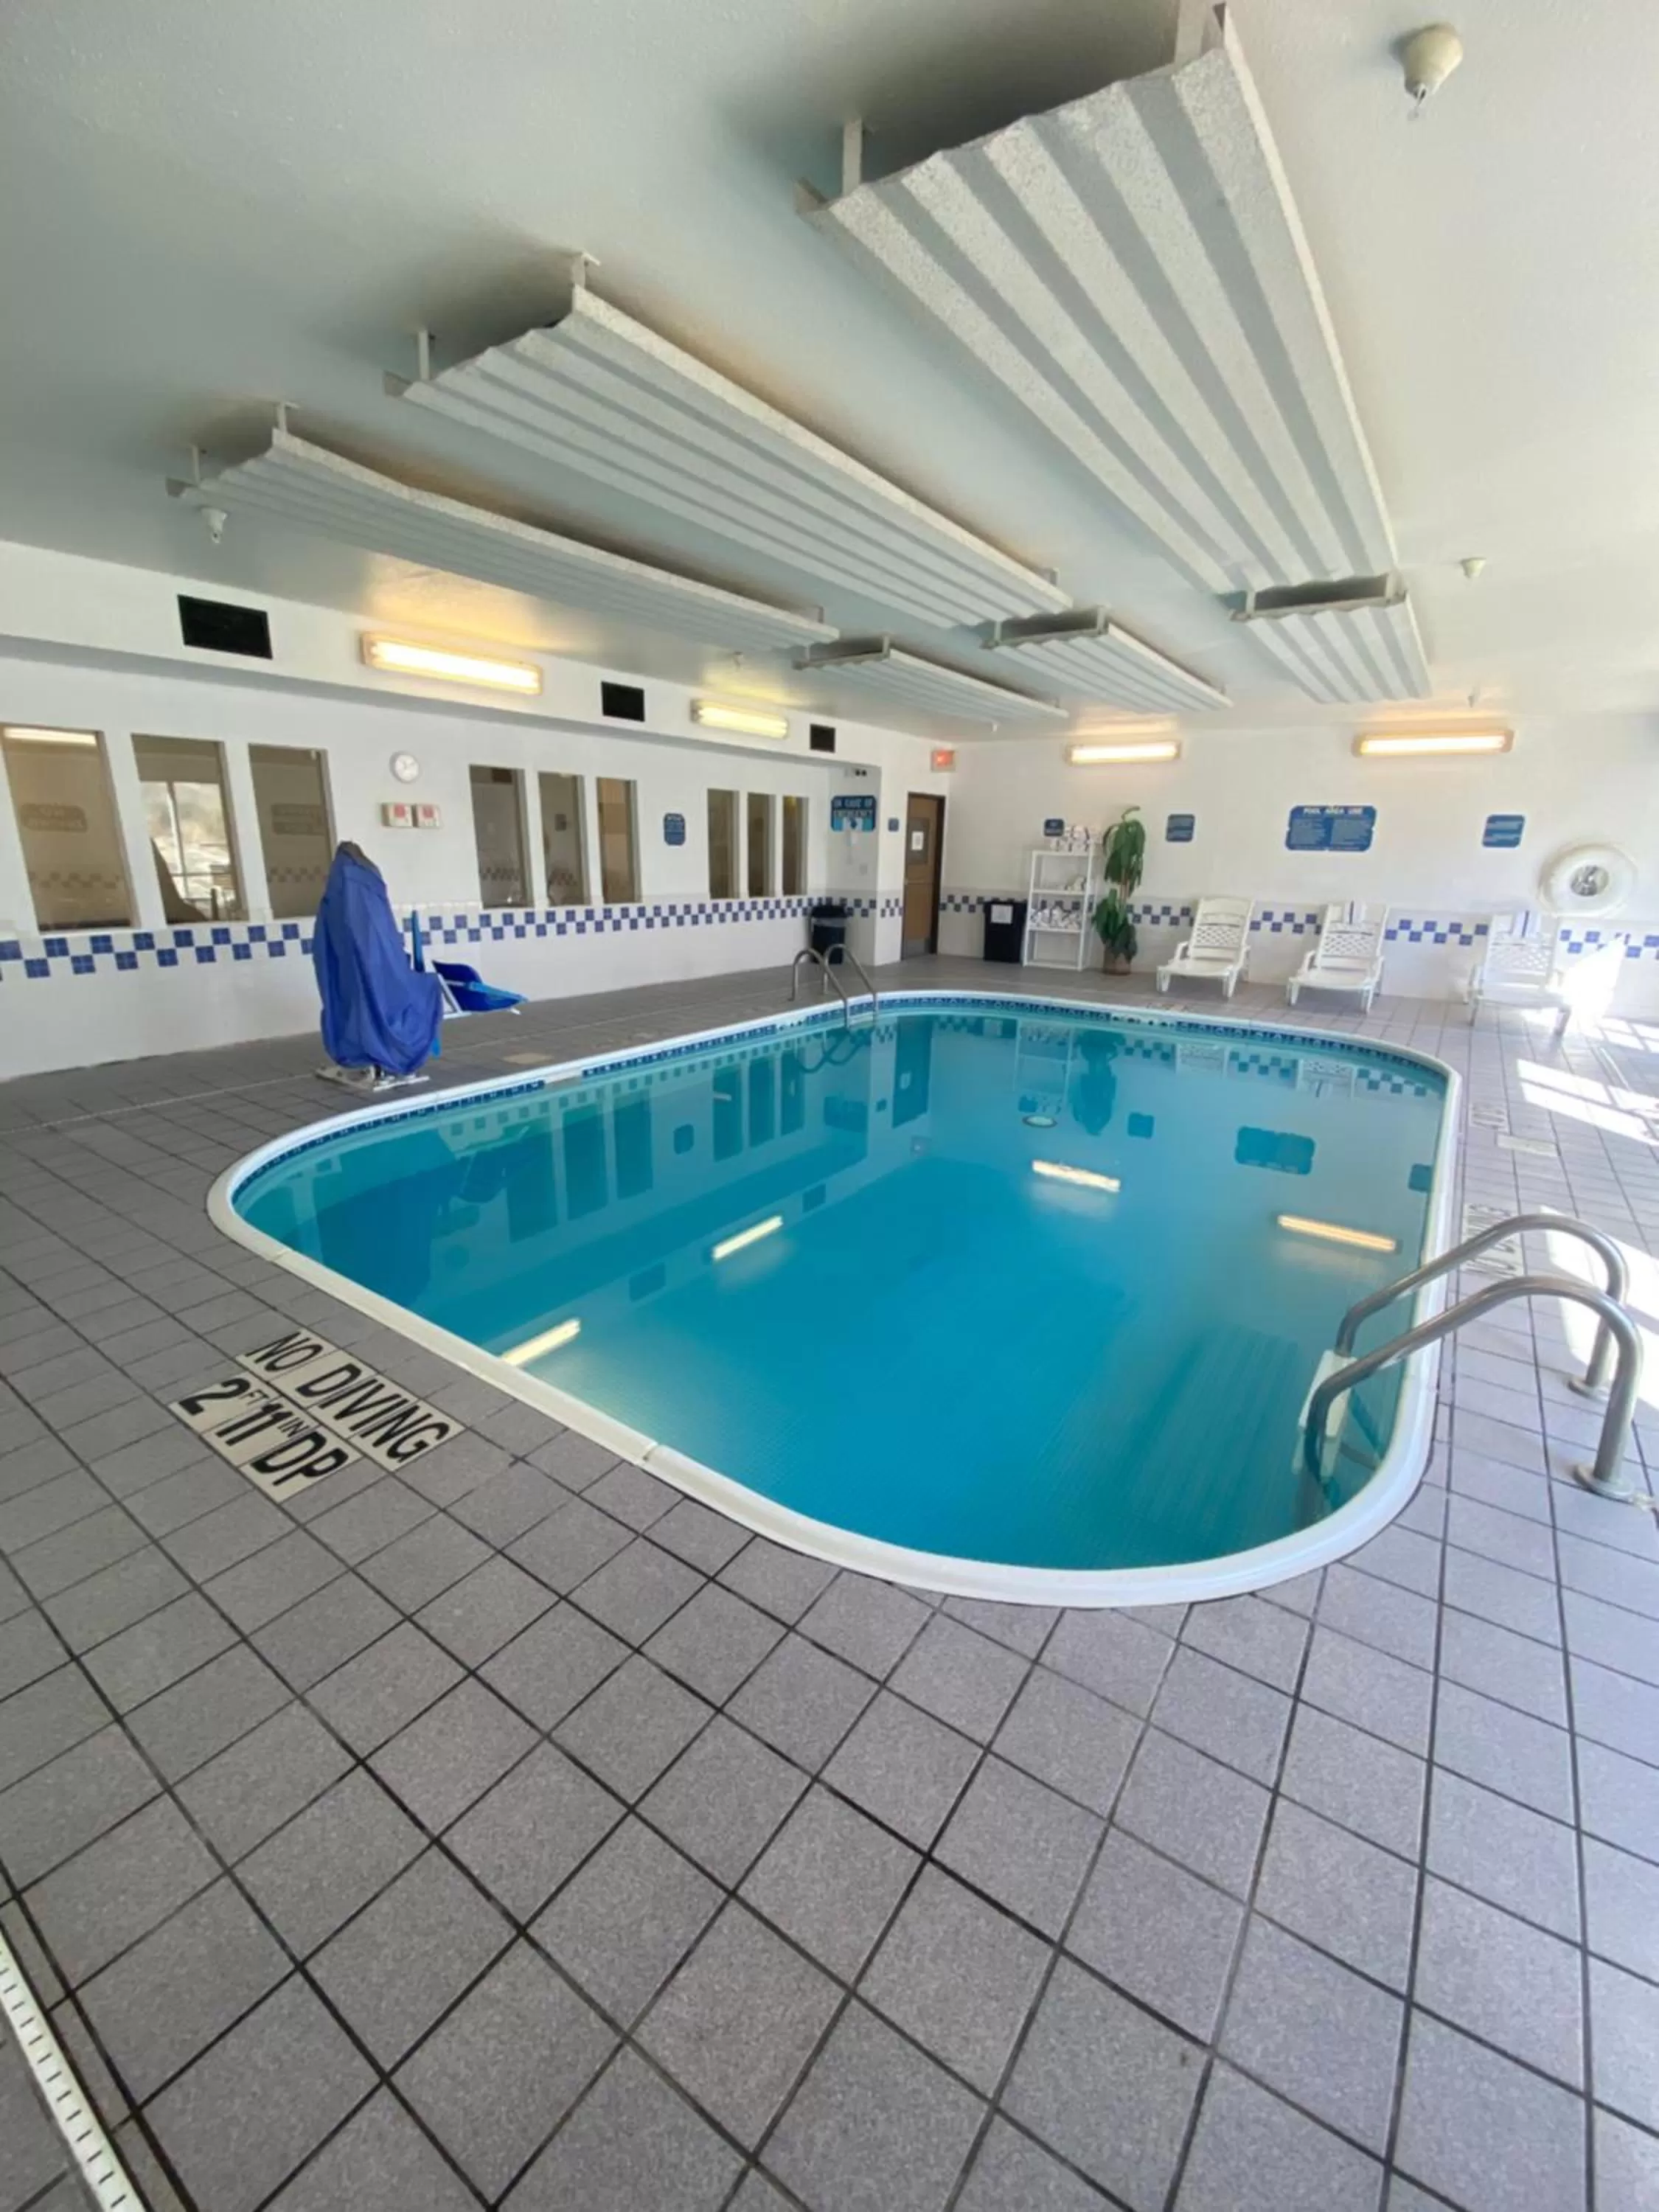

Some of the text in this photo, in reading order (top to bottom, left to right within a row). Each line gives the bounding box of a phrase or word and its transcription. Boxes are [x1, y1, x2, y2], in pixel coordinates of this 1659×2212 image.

[244, 1332, 450, 1463] NO DIVING
[250, 1430, 349, 1486] DP
